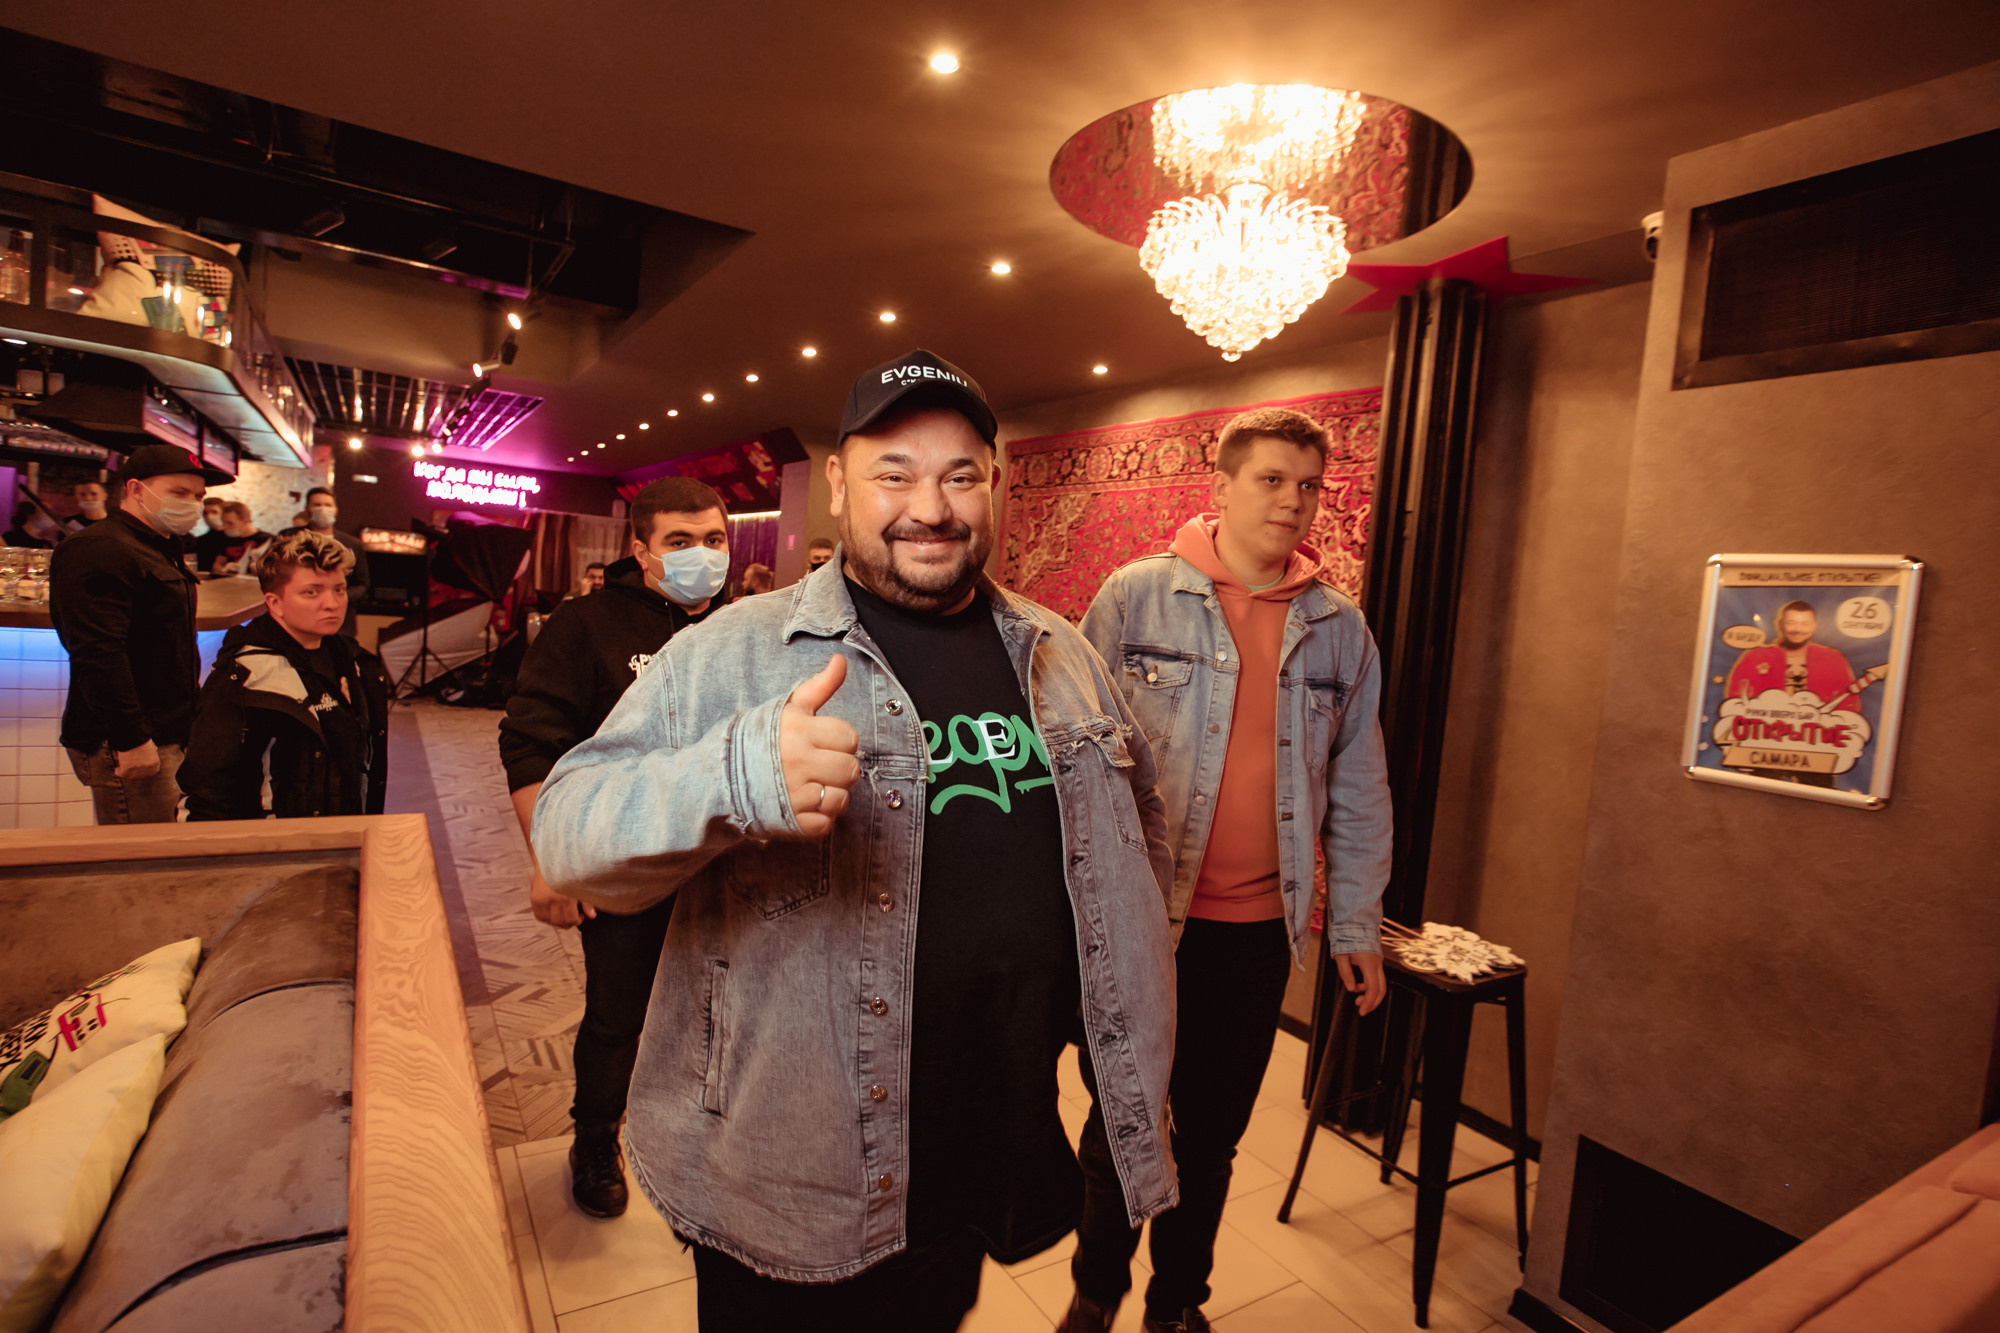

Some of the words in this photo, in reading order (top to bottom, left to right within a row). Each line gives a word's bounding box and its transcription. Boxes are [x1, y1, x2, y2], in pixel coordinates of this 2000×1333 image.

[1851, 601, 1879, 619] 26
[1732, 715, 1852, 748] ОТКРЫТИЕ
[1749, 751, 1811, 768] САМАРА
